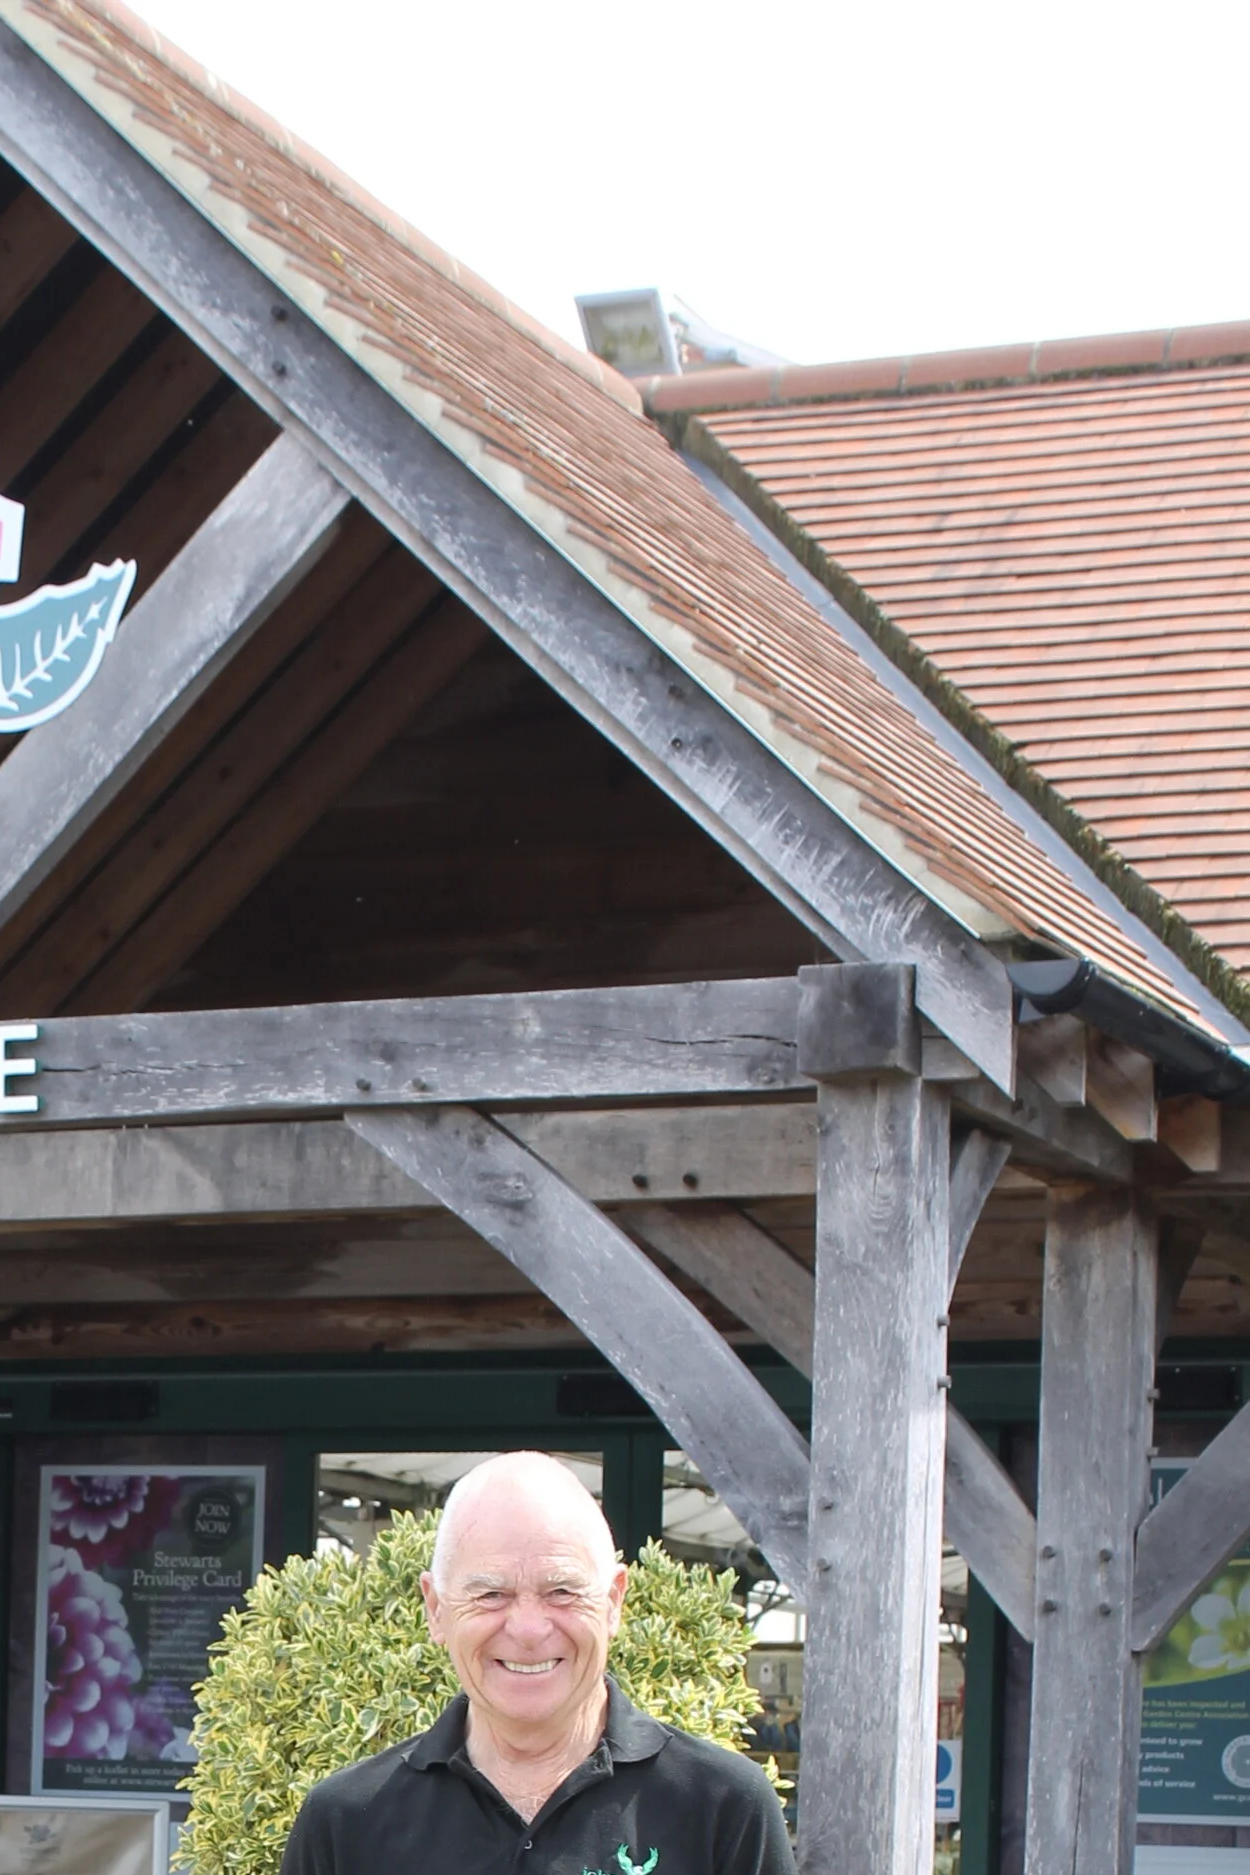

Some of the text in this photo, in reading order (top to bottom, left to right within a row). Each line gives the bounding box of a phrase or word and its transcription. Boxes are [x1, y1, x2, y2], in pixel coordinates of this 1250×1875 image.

[197, 1502, 230, 1518] JOIN
[194, 1519, 231, 1534] NOW
[153, 1551, 222, 1568] Stewarts
[132, 1569, 243, 1591] Privilege Card
